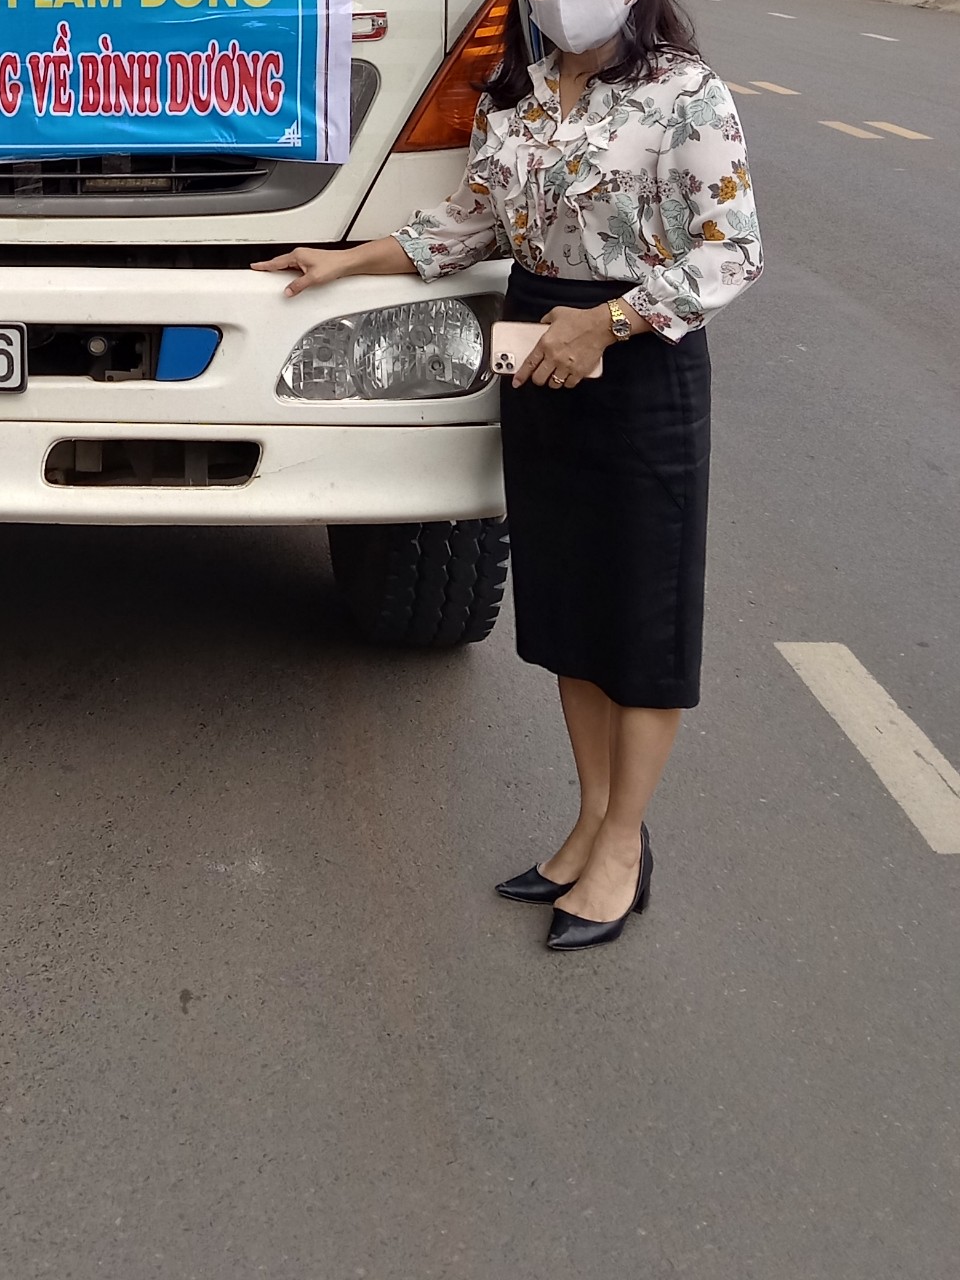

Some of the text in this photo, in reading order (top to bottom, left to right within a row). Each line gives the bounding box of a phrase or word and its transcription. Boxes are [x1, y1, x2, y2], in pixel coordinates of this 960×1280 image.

[27, 20, 75, 117] VỀ
[78, 33, 159, 116] BÌNH
[168, 40, 284, 116] DƯƠNG
